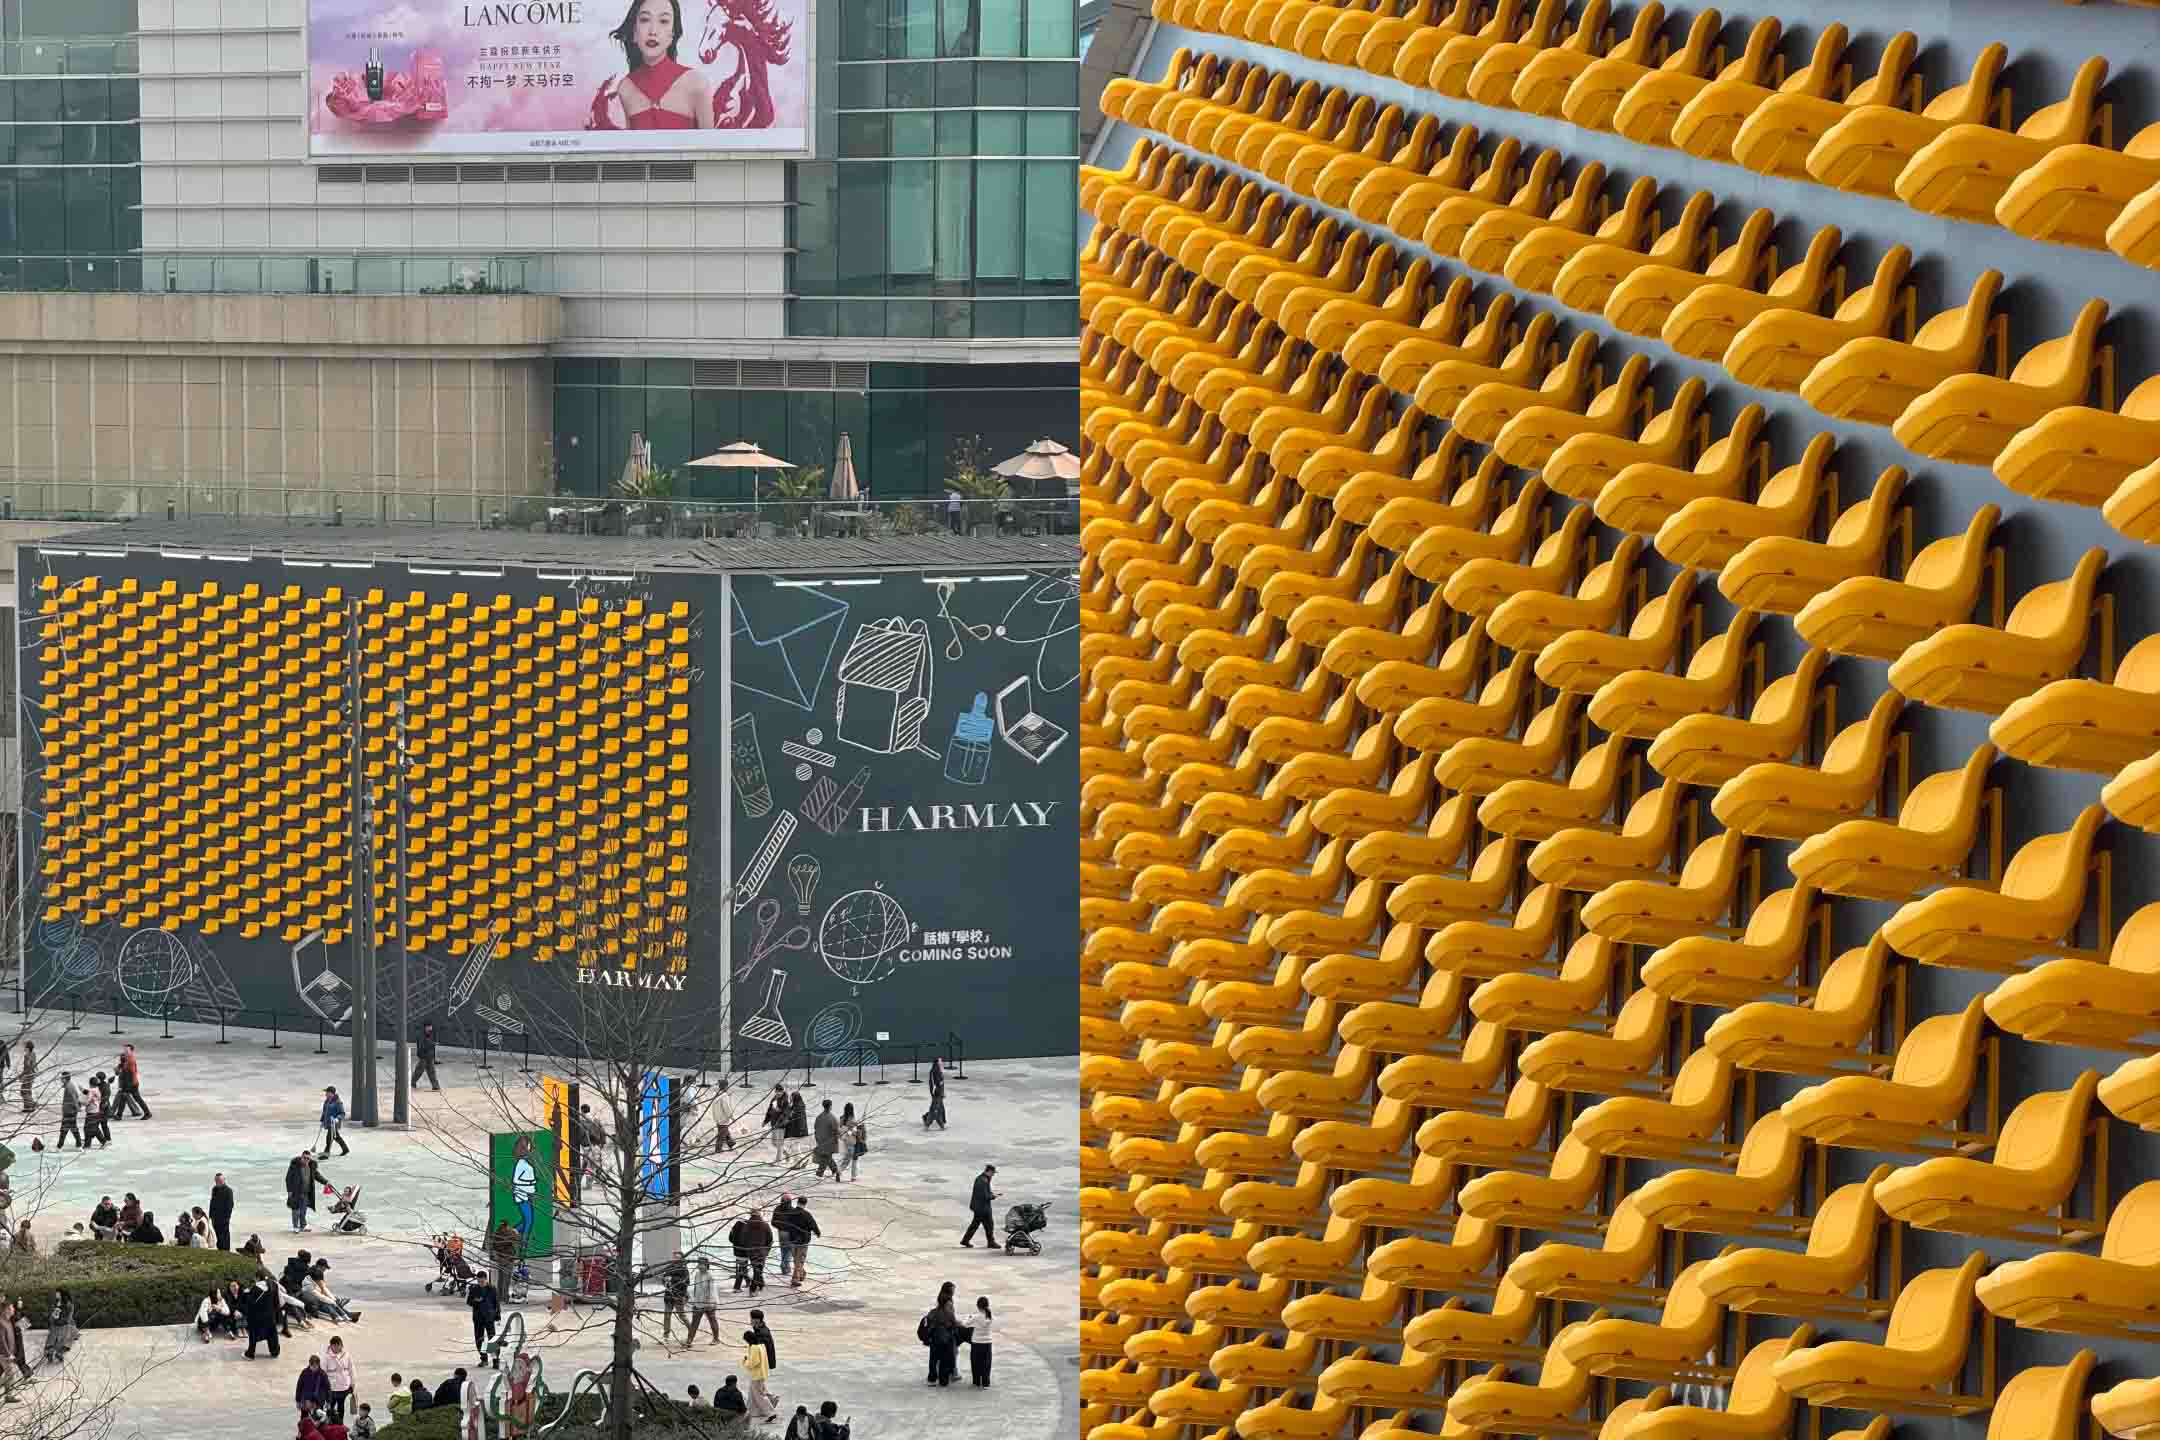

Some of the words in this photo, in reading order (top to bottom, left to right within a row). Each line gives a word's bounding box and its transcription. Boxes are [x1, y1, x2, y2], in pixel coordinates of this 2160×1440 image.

[467, 75, 516, 88] 不拘一梦
[523, 73, 575, 88] 天马行空
[857, 801, 1062, 832] HARMAY
[899, 947, 963, 963] COMING
[967, 945, 1012, 960] SOON
[576, 968, 687, 990] HARMAY
